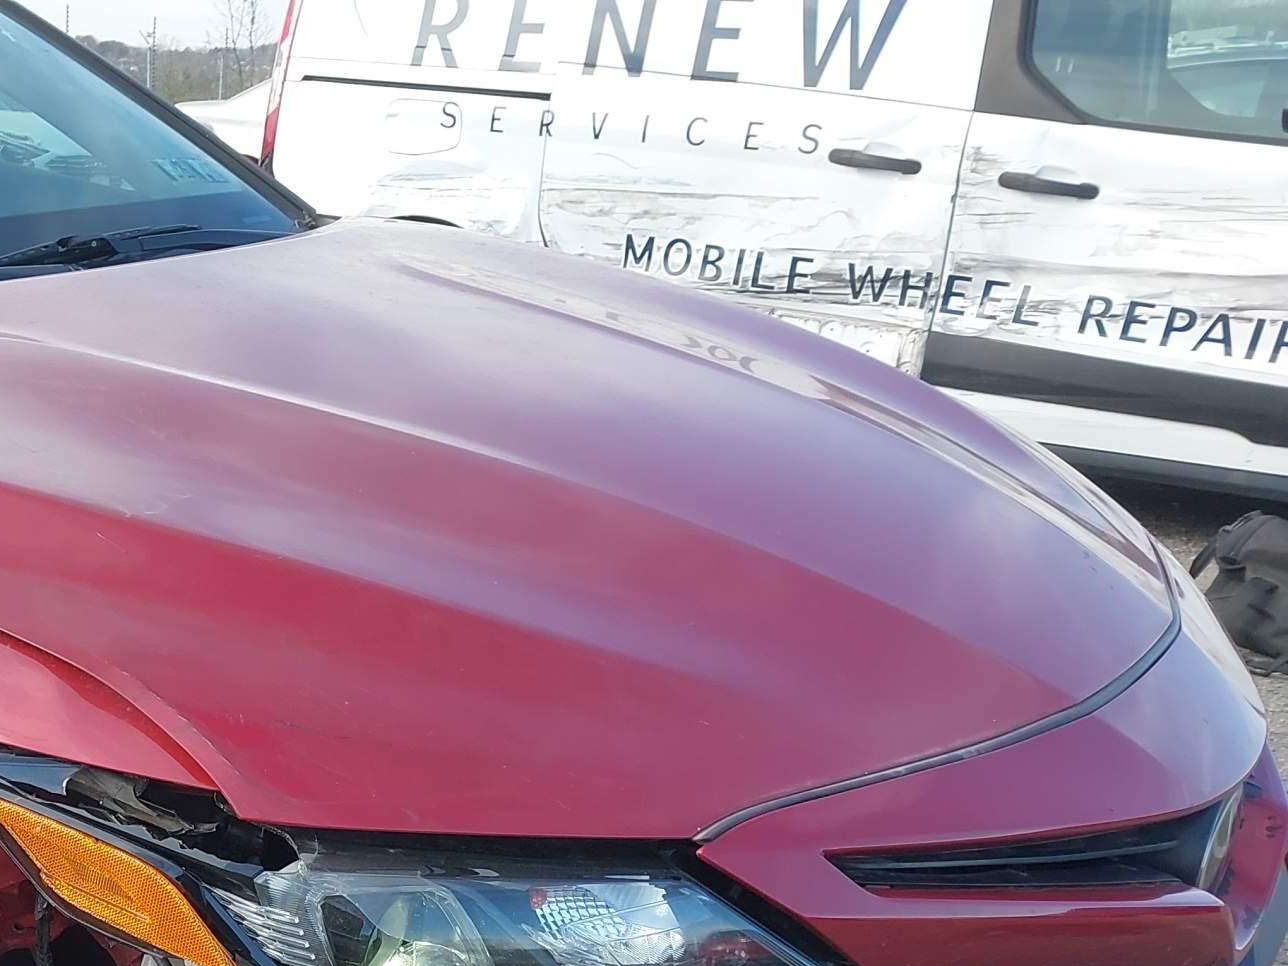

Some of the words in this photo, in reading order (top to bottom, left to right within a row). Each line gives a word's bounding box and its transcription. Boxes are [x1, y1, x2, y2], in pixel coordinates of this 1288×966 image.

[410, 0, 909, 91] RENEW
[439, 101, 824, 155] SERVICES
[621, 233, 815, 295] MOBILE
[847, 262, 1042, 327] WHEEL
